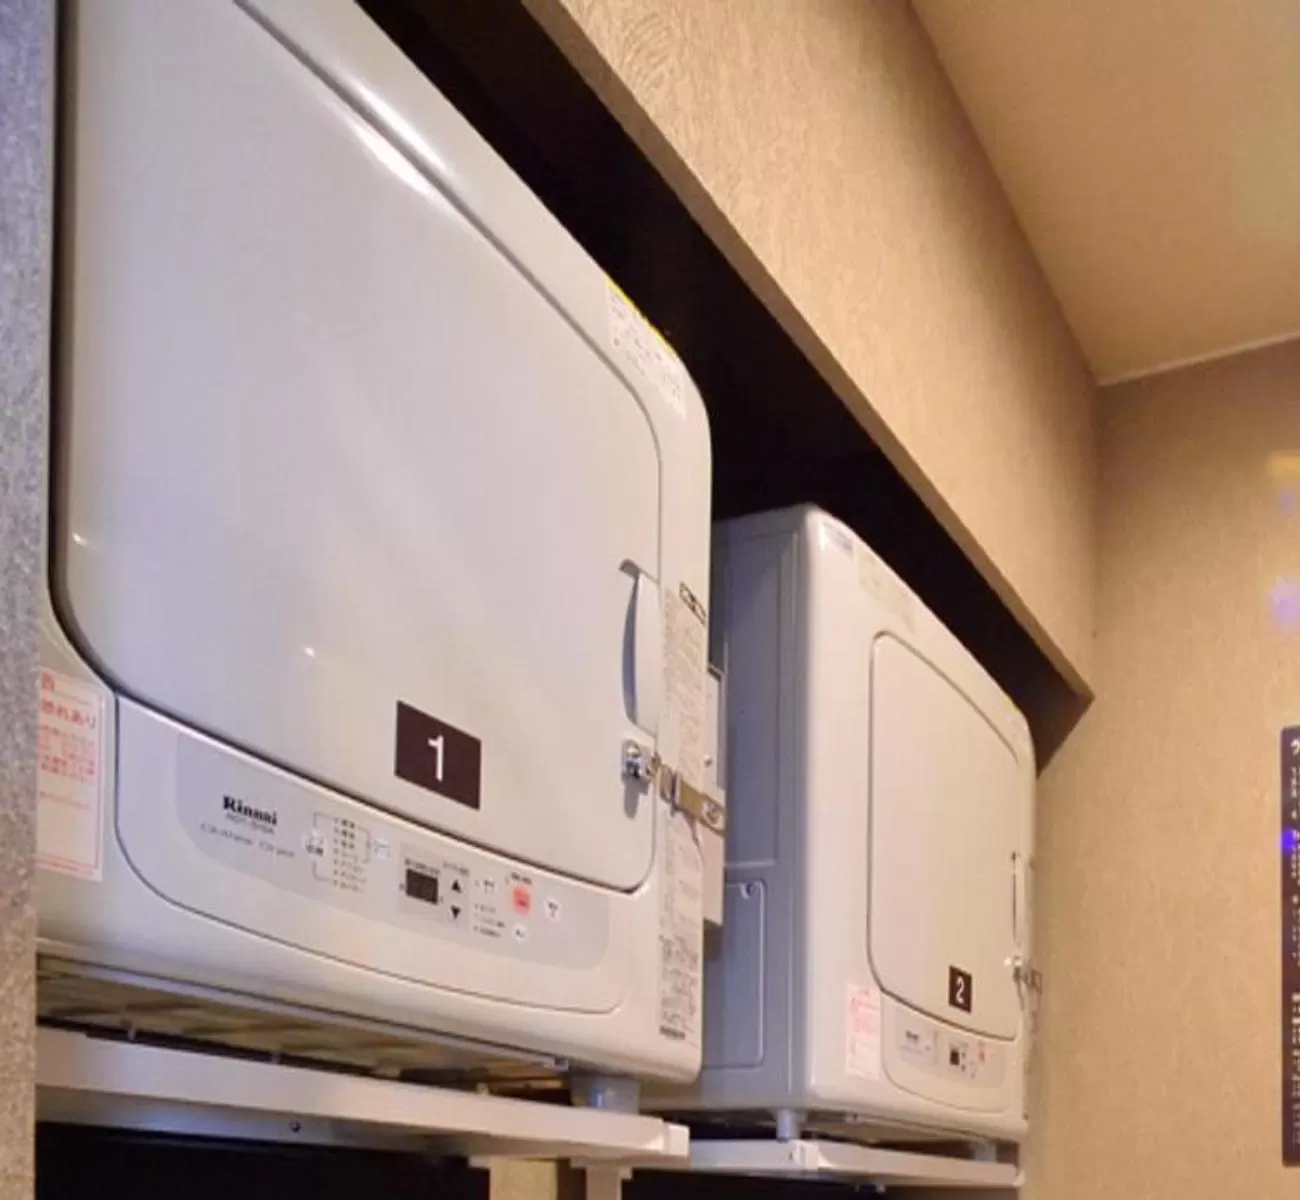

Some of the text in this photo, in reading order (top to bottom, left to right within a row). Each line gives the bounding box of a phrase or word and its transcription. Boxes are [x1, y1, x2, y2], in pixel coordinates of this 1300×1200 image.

[427, 734, 445, 782] 1
[222, 795, 278, 827] Rinnai
[954, 975, 966, 1004] 2
